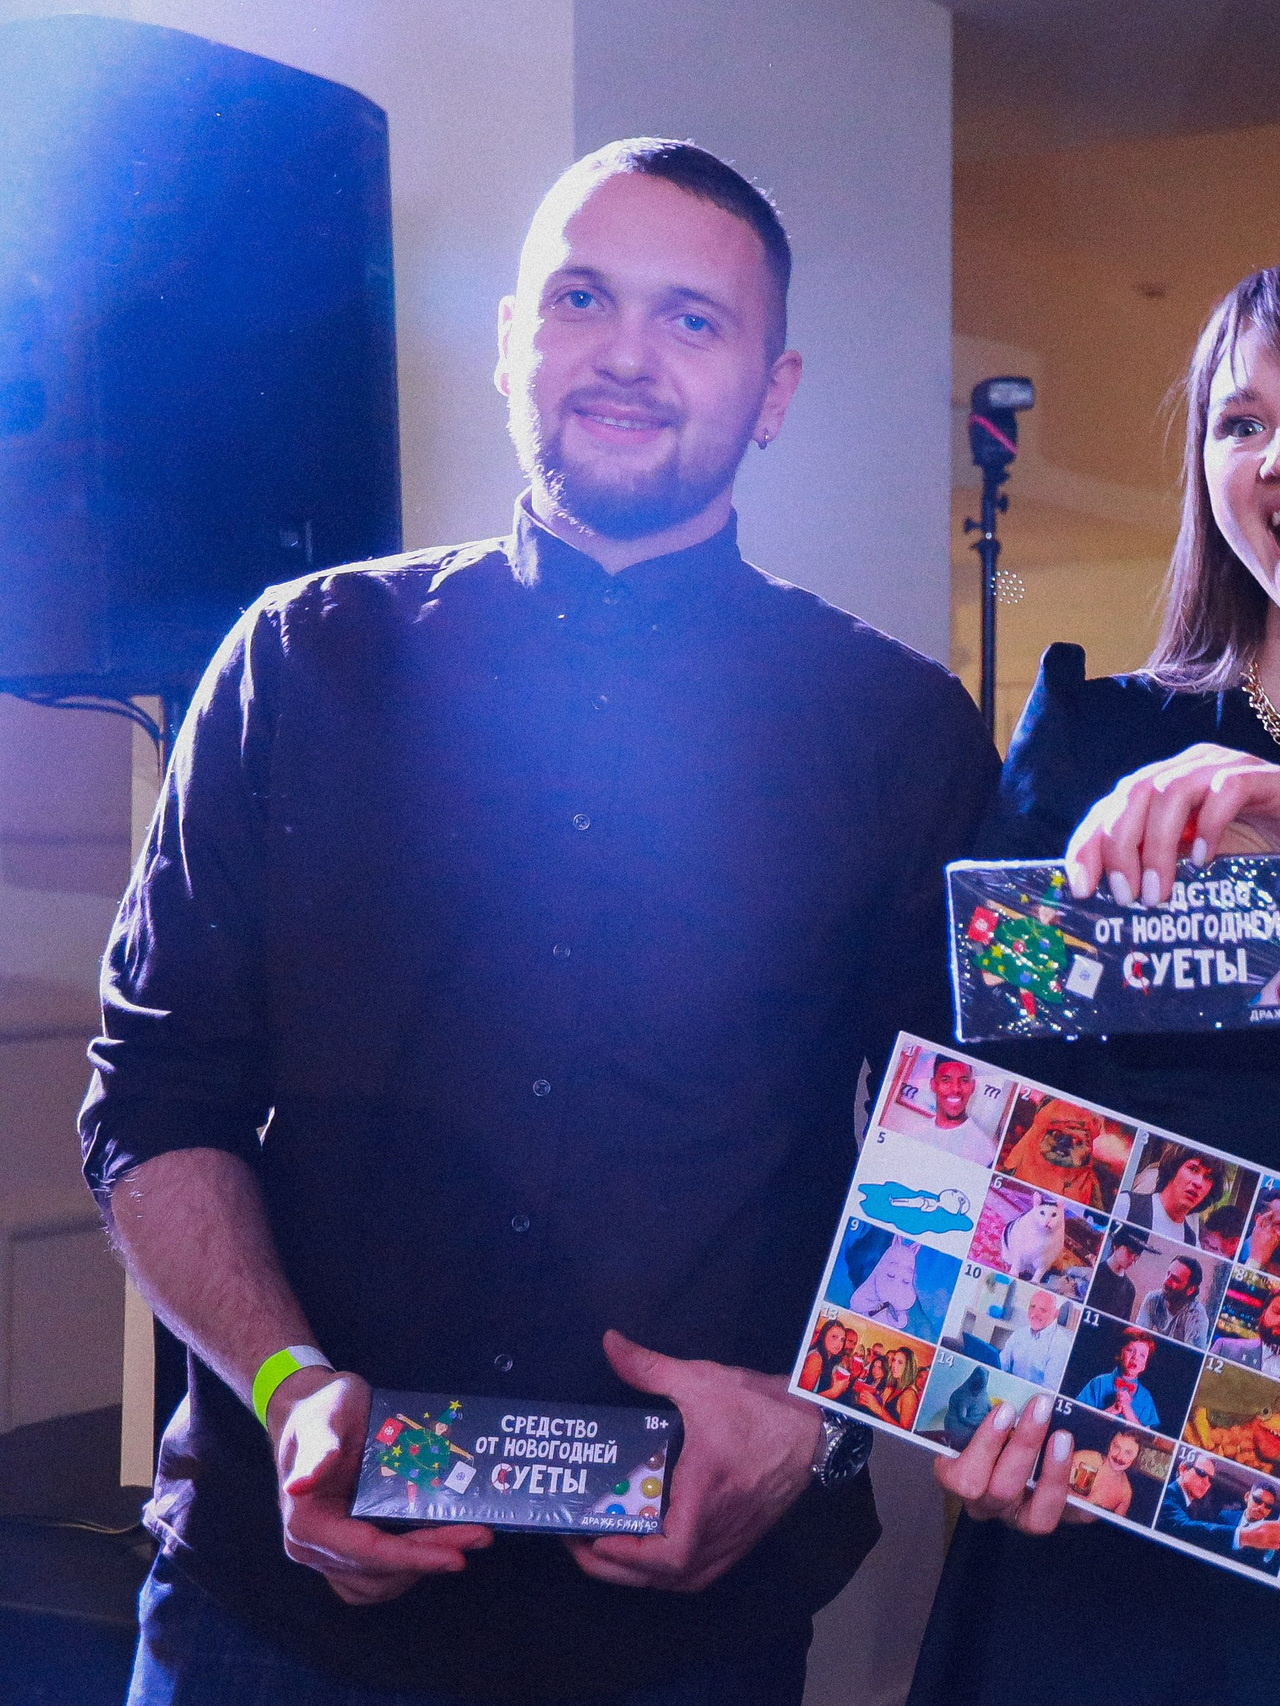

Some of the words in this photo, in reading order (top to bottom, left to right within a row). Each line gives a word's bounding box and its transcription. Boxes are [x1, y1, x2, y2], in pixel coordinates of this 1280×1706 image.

[1095, 917, 1124, 943] ОТ
[1123, 948, 1249, 990] СУЕТЫ
[1021, 1087, 1032, 1101] 2
[877, 1131, 886, 1144] 5
[1140, 1131, 1150, 1145] 3
[994, 1177, 1003, 1189] 6
[1265, 1177, 1275, 1191] 4
[850, 1219, 859, 1231] 9
[1112, 1221, 1123, 1235] 7
[964, 1264, 982, 1278] 10
[1236, 1268, 1245, 1281] 8
[821, 1304, 840, 1320] 13
[1083, 1310, 1100, 1327] 11
[937, 1352, 955, 1367] 14
[1206, 1357, 1224, 1374] 12
[1055, 1399, 1073, 1415] 15
[501, 1414, 598, 1438] СРЕДСТВО
[644, 1416, 669, 1430] 18+
[475, 1437, 498, 1455] ОТ
[503, 1438, 618, 1464] НОВОГОДНЕЙ
[1179, 1447, 1196, 1463] 16
[491, 1463, 588, 1495] СУЕТЫ
